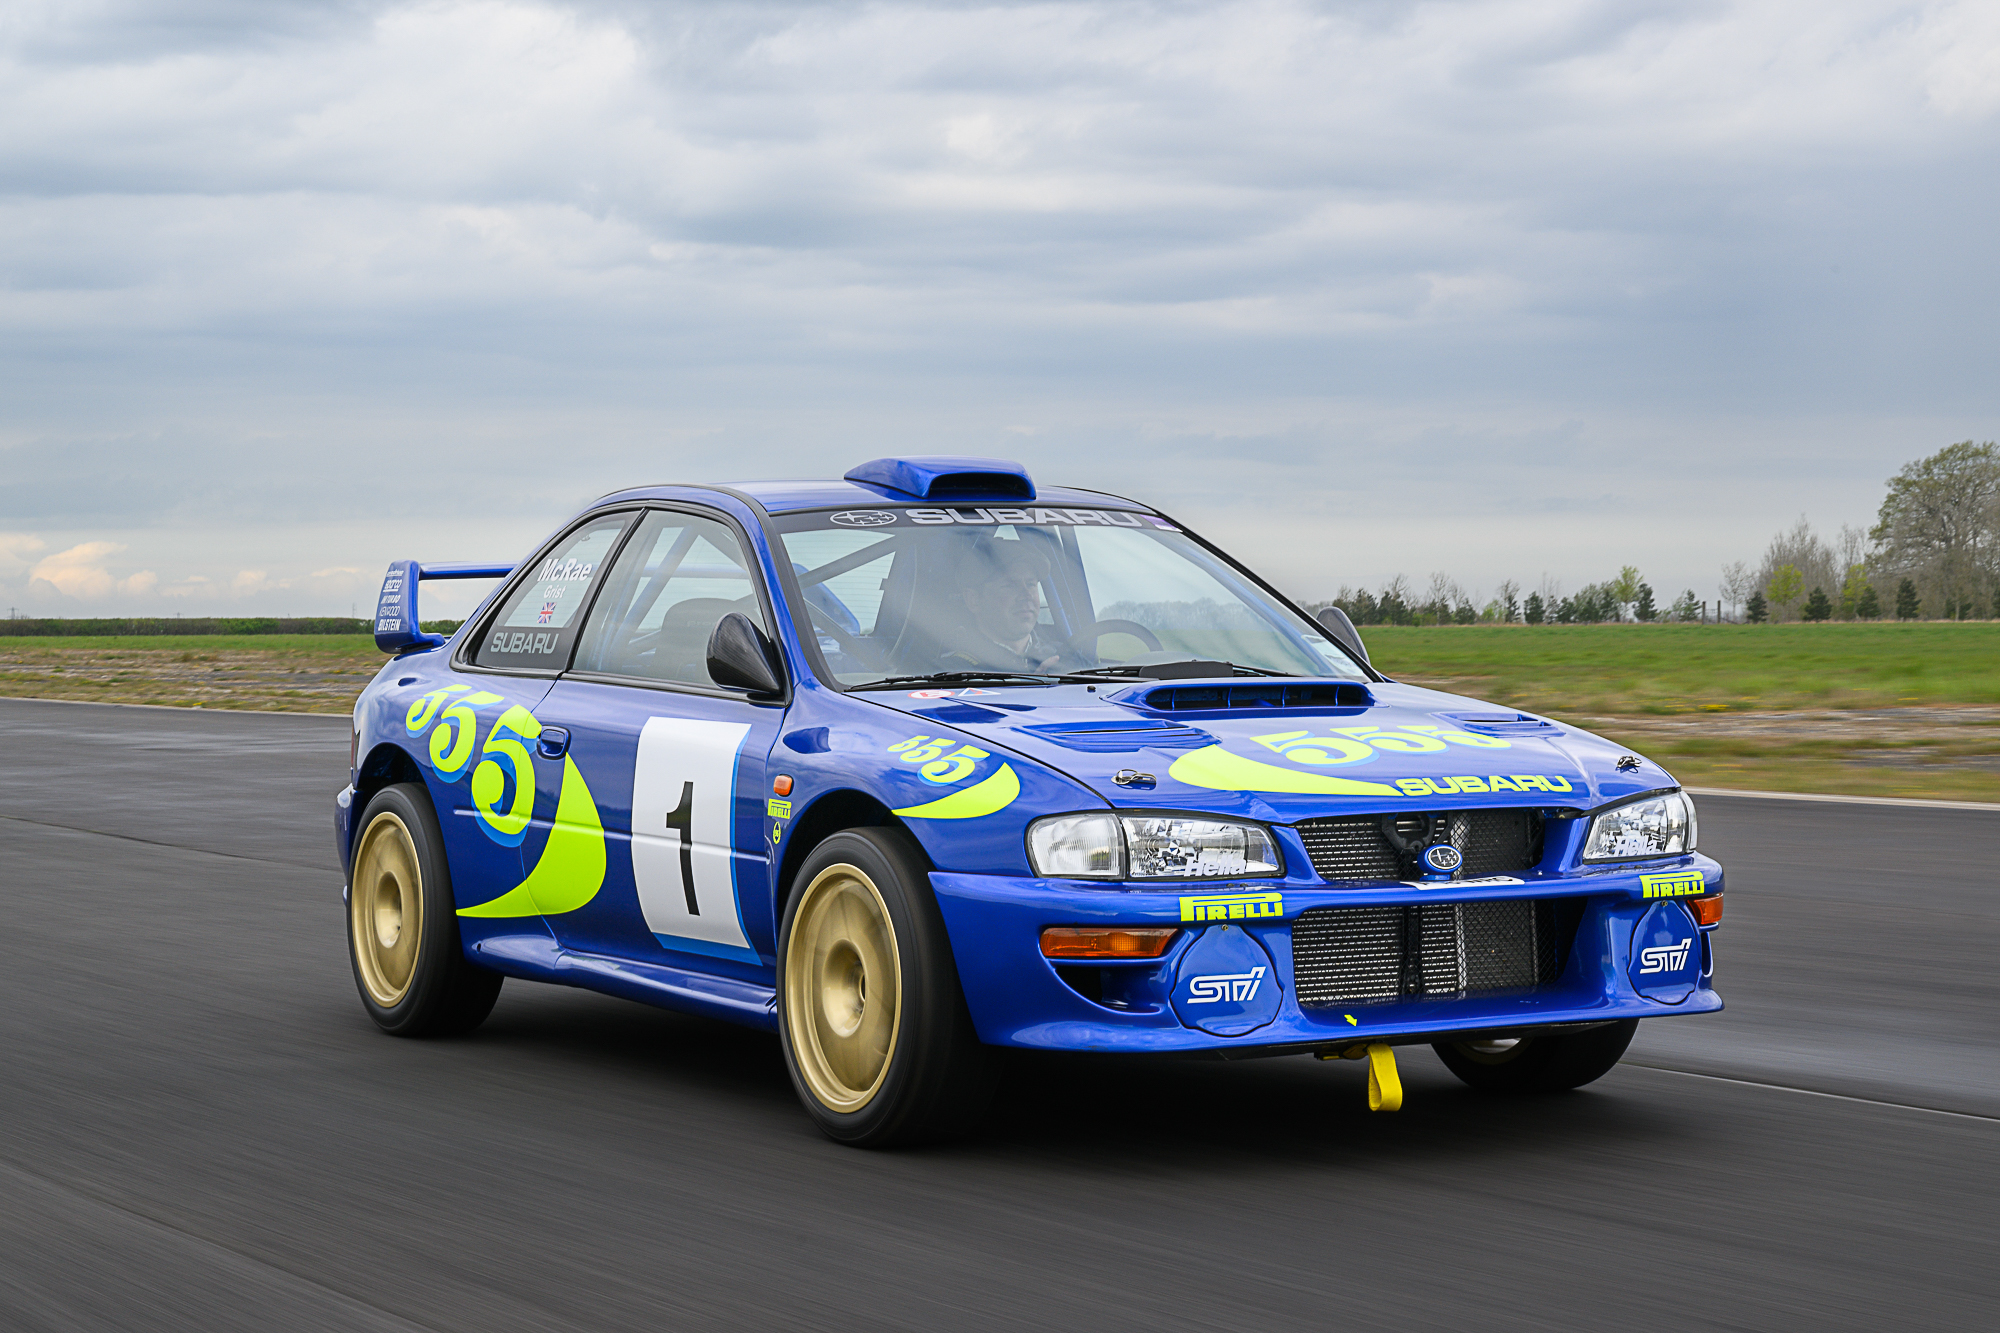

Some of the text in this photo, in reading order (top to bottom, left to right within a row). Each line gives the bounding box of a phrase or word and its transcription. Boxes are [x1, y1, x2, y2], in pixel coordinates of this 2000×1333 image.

[905, 508, 1142, 527] SUBARU
[537, 558, 592, 582] McRae
[543, 585, 567, 599] Grist
[380, 606, 400, 616] KENWOOD
[378, 619, 401, 631] BILSTEIN
[490, 632, 560, 654] SUBARU
[1250, 725, 1513, 768] 555
[406, 684, 543, 847] 555
[887, 735, 991, 786] 555
[1395, 775, 1573, 797] SUBARU
[767, 798, 792, 820] PIRELLI
[666, 781, 700, 916] 1
[1614, 835, 1658, 857] Hella
[1184, 855, 1247, 877] Hella
[1639, 871, 1705, 898] PIRELLI
[1179, 892, 1284, 922] PIRELLI
